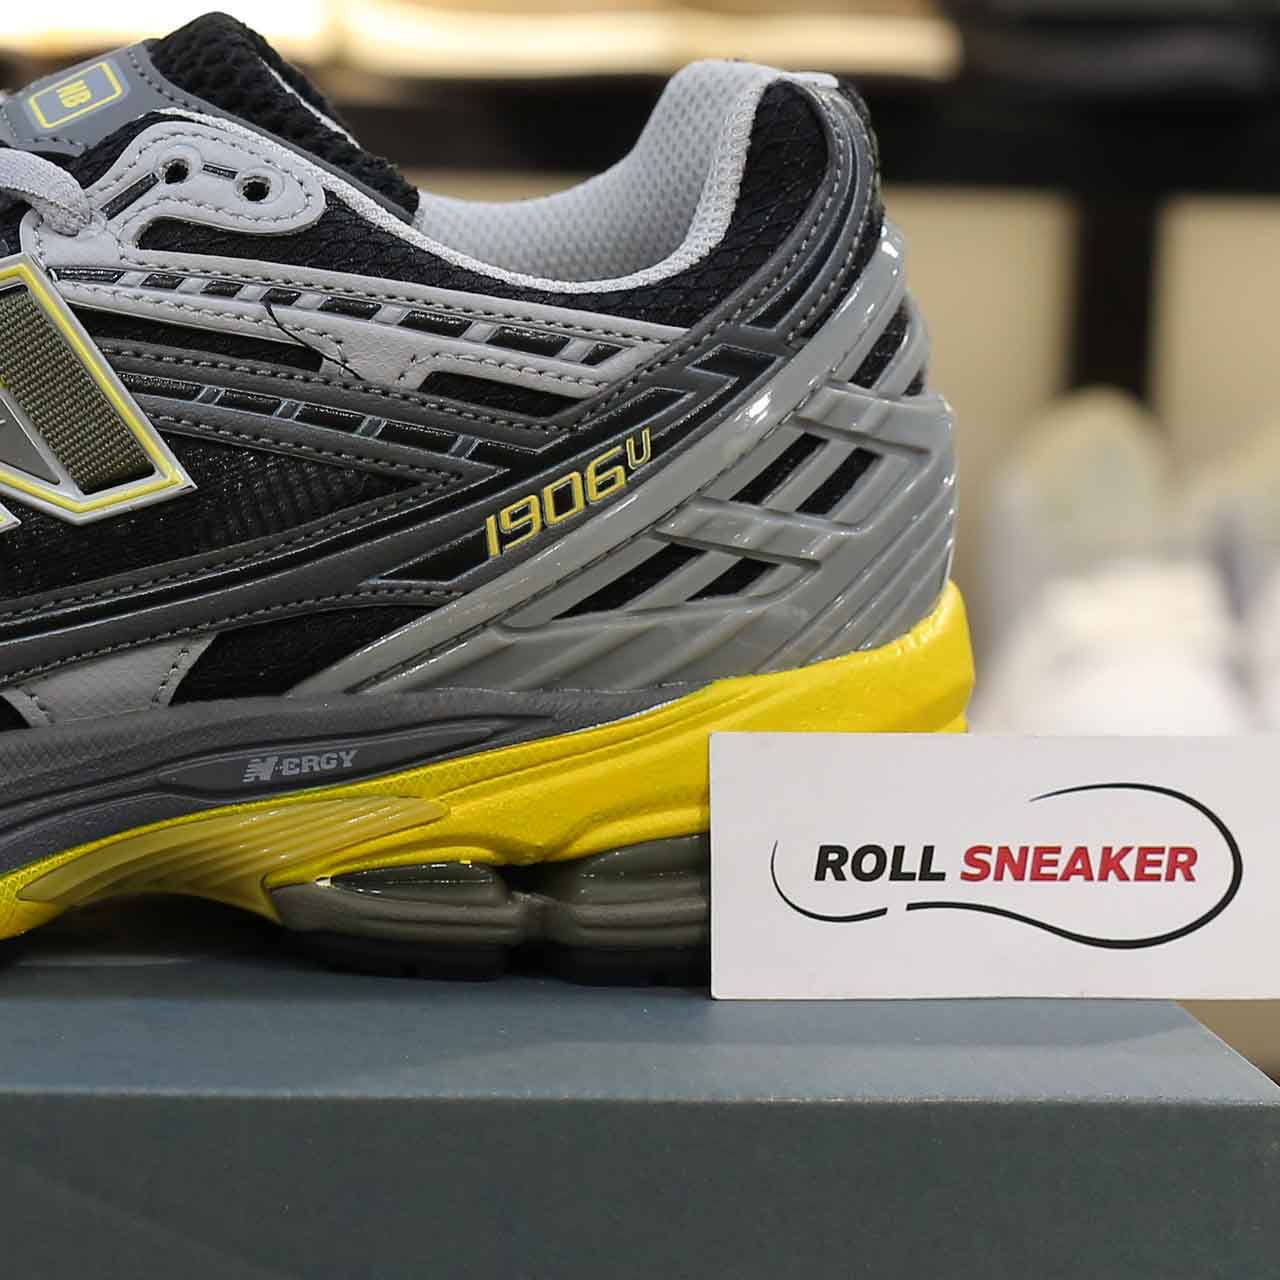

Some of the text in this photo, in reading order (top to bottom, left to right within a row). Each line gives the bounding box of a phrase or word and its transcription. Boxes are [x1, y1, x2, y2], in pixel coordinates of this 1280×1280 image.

[56, 80, 91, 108] NB
[814, 845, 1198, 881] ROLL SNEAKER
